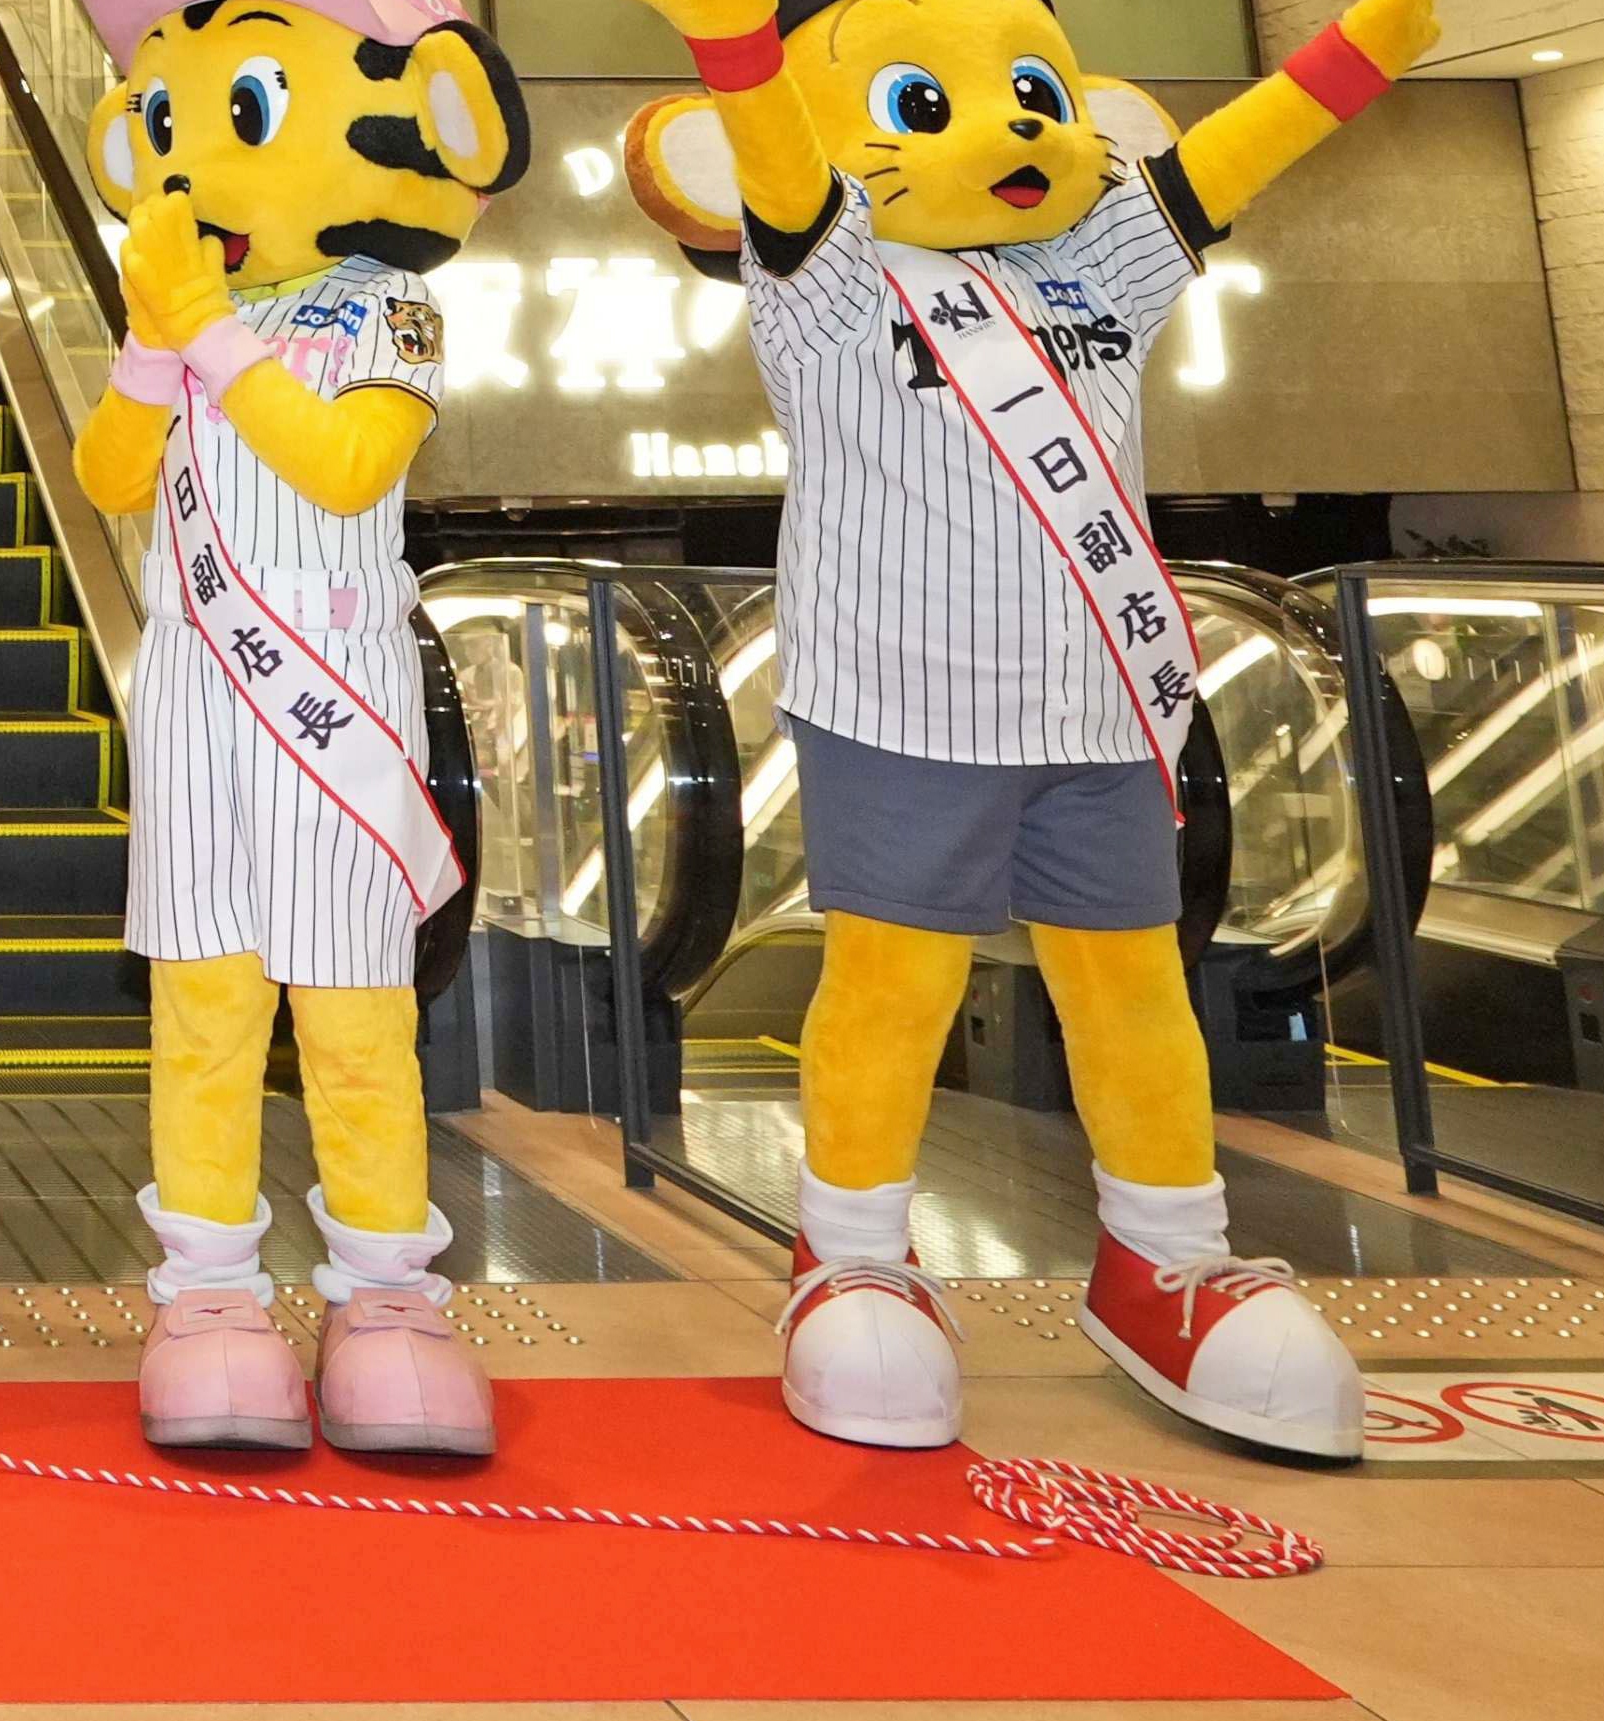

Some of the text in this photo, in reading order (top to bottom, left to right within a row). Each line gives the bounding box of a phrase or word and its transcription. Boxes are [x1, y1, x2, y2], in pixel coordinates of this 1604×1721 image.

[990, 385, 1196, 719] 一日副店長
